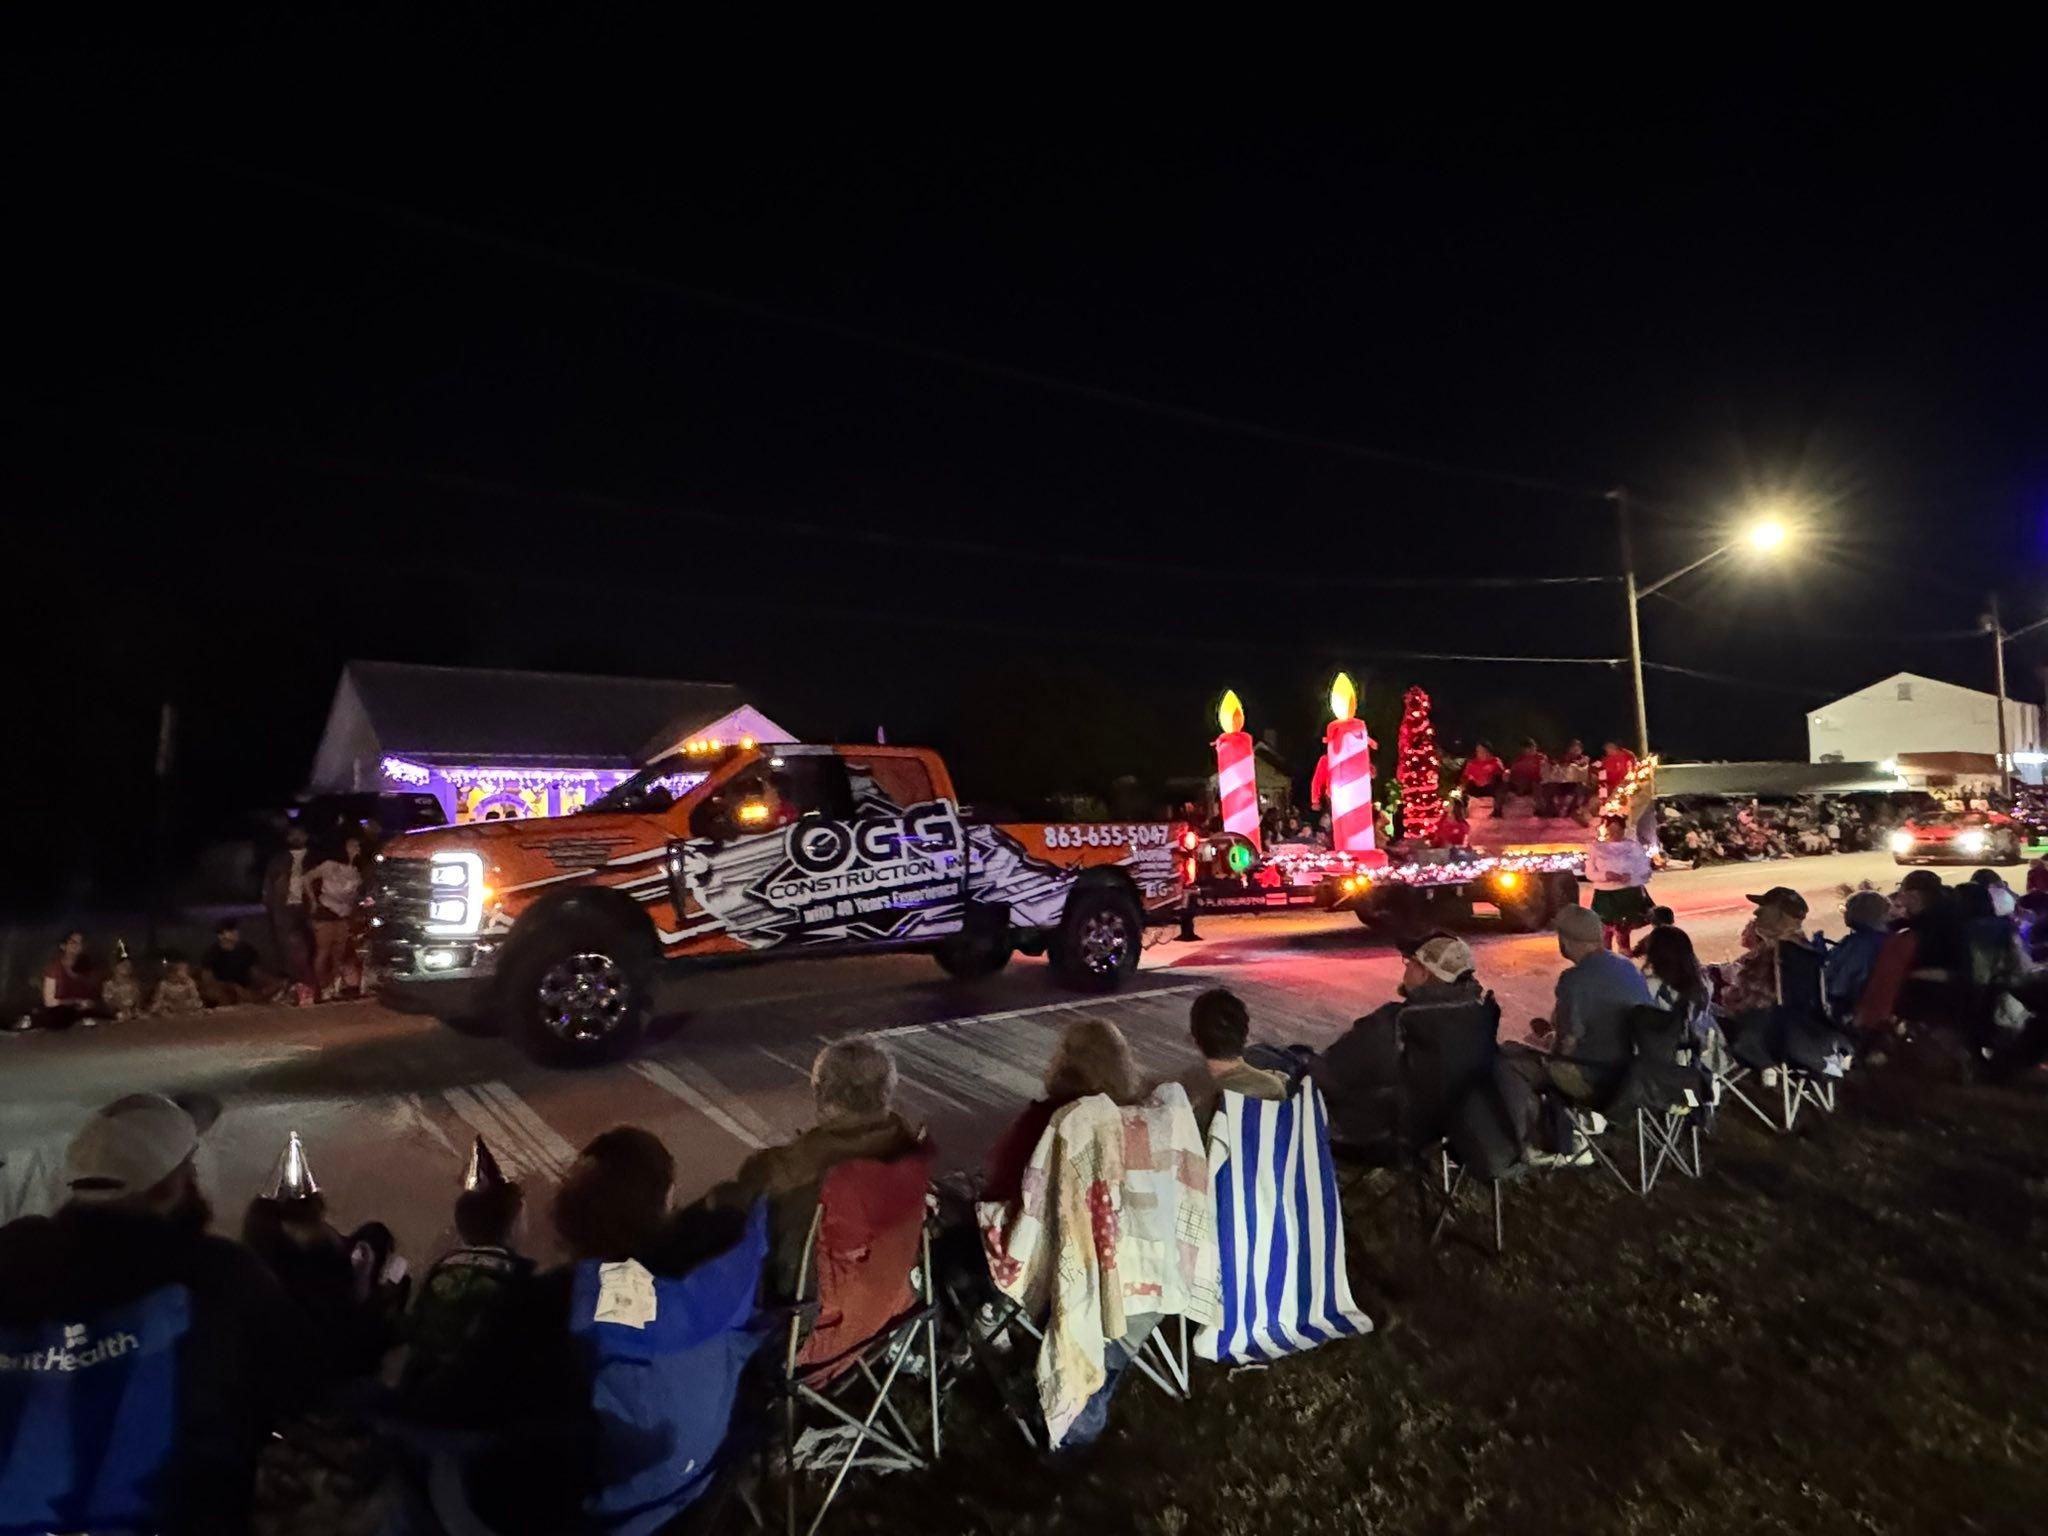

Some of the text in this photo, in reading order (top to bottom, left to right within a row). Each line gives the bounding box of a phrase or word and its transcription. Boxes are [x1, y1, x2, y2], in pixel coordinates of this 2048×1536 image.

[789, 801, 958, 873] OGG
[1044, 824, 1169, 848] 863-655-5047
[769, 857, 936, 900] CONSTRUCTION
